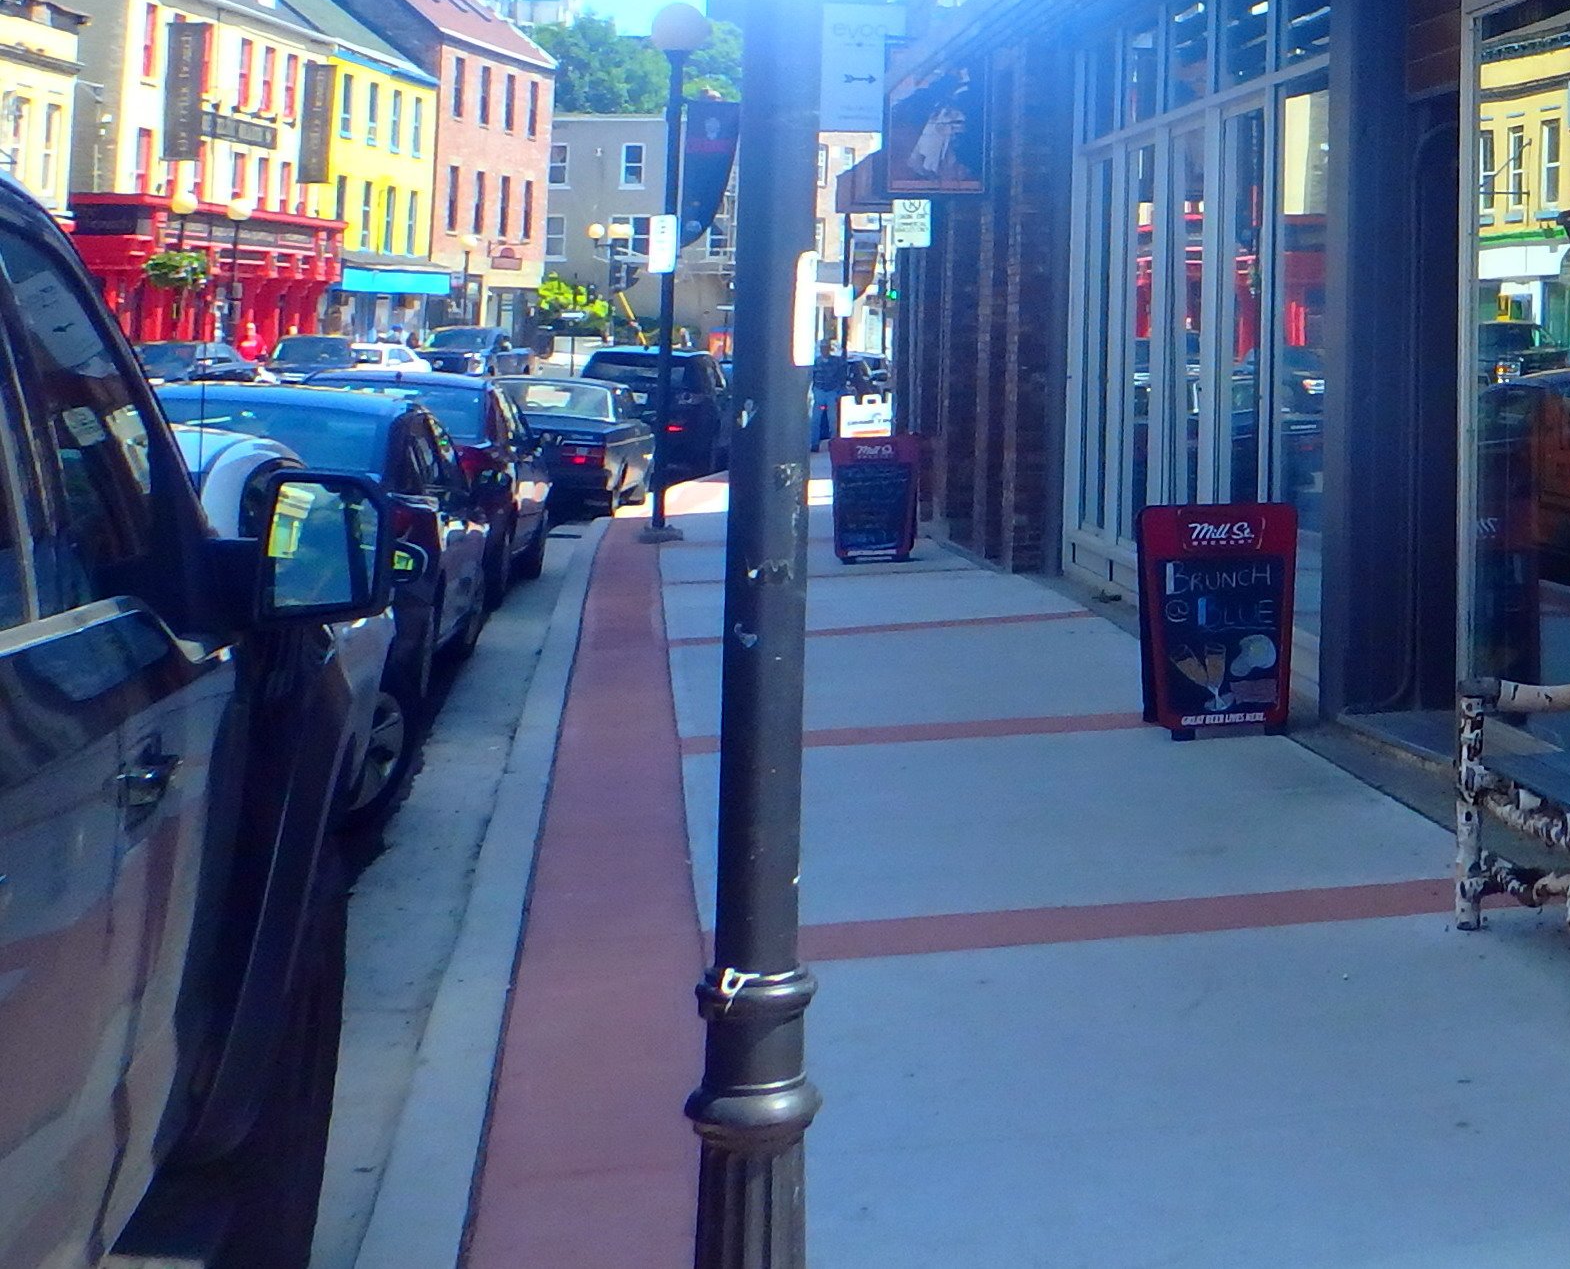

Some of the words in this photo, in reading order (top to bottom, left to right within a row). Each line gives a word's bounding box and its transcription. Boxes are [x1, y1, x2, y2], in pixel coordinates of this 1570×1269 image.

[1188, 523, 1230, 539] Mill
[1165, 561, 1271, 595] BRUNCH
[1225, 712, 1245, 723] LIVES
